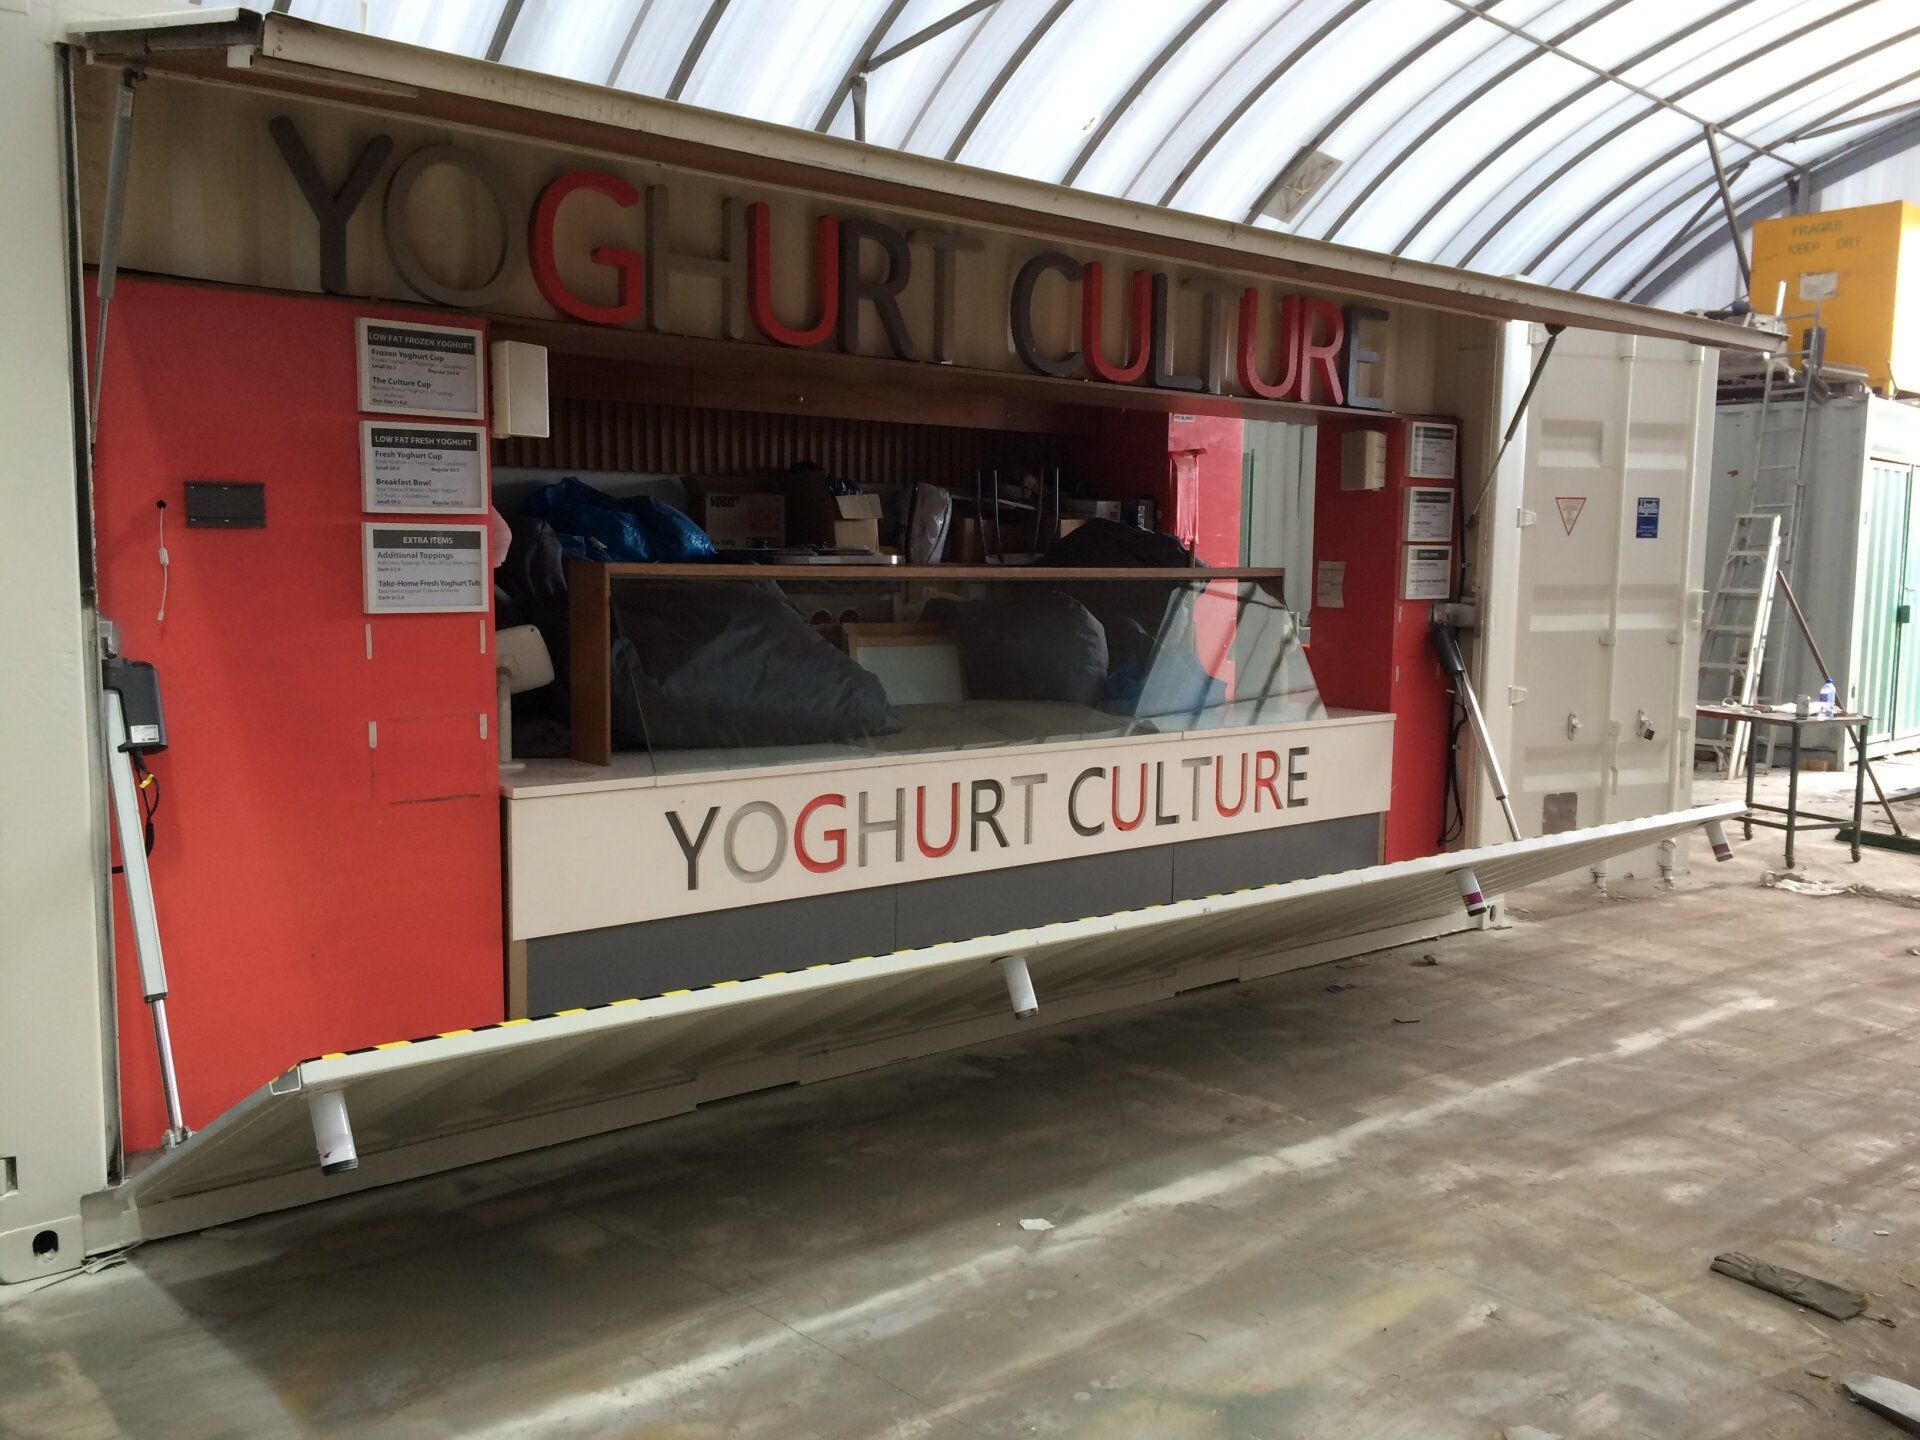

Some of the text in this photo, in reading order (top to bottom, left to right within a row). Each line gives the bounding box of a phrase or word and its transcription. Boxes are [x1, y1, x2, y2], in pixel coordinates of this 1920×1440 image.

[1792, 220, 1843, 236] FRAGILE
[1788, 236, 1863, 255] KEEP DRY
[268, 114, 1390, 408] YOGHURT CULTURE
[368, 332, 473, 350] LOW FAT FROZEN YOGHURT
[371, 348, 445, 363] Frozen Yoghurt Cup
[372, 376, 432, 389] The Culture Cup
[375, 435, 473, 447] LOW FAT FRESH YOGHURT
[375, 450, 443, 461] Fresh Yoghurt Cup
[376, 477, 432, 487] Breakfast Bowl
[403, 536, 454, 545] EXTRA ITEMS
[377, 551, 454, 561] Additional Toppings
[378, 579, 481, 588] Take-Home Fresh Yoghurt Tub
[664, 746, 1310, 890] YOGHURT CULTURE
